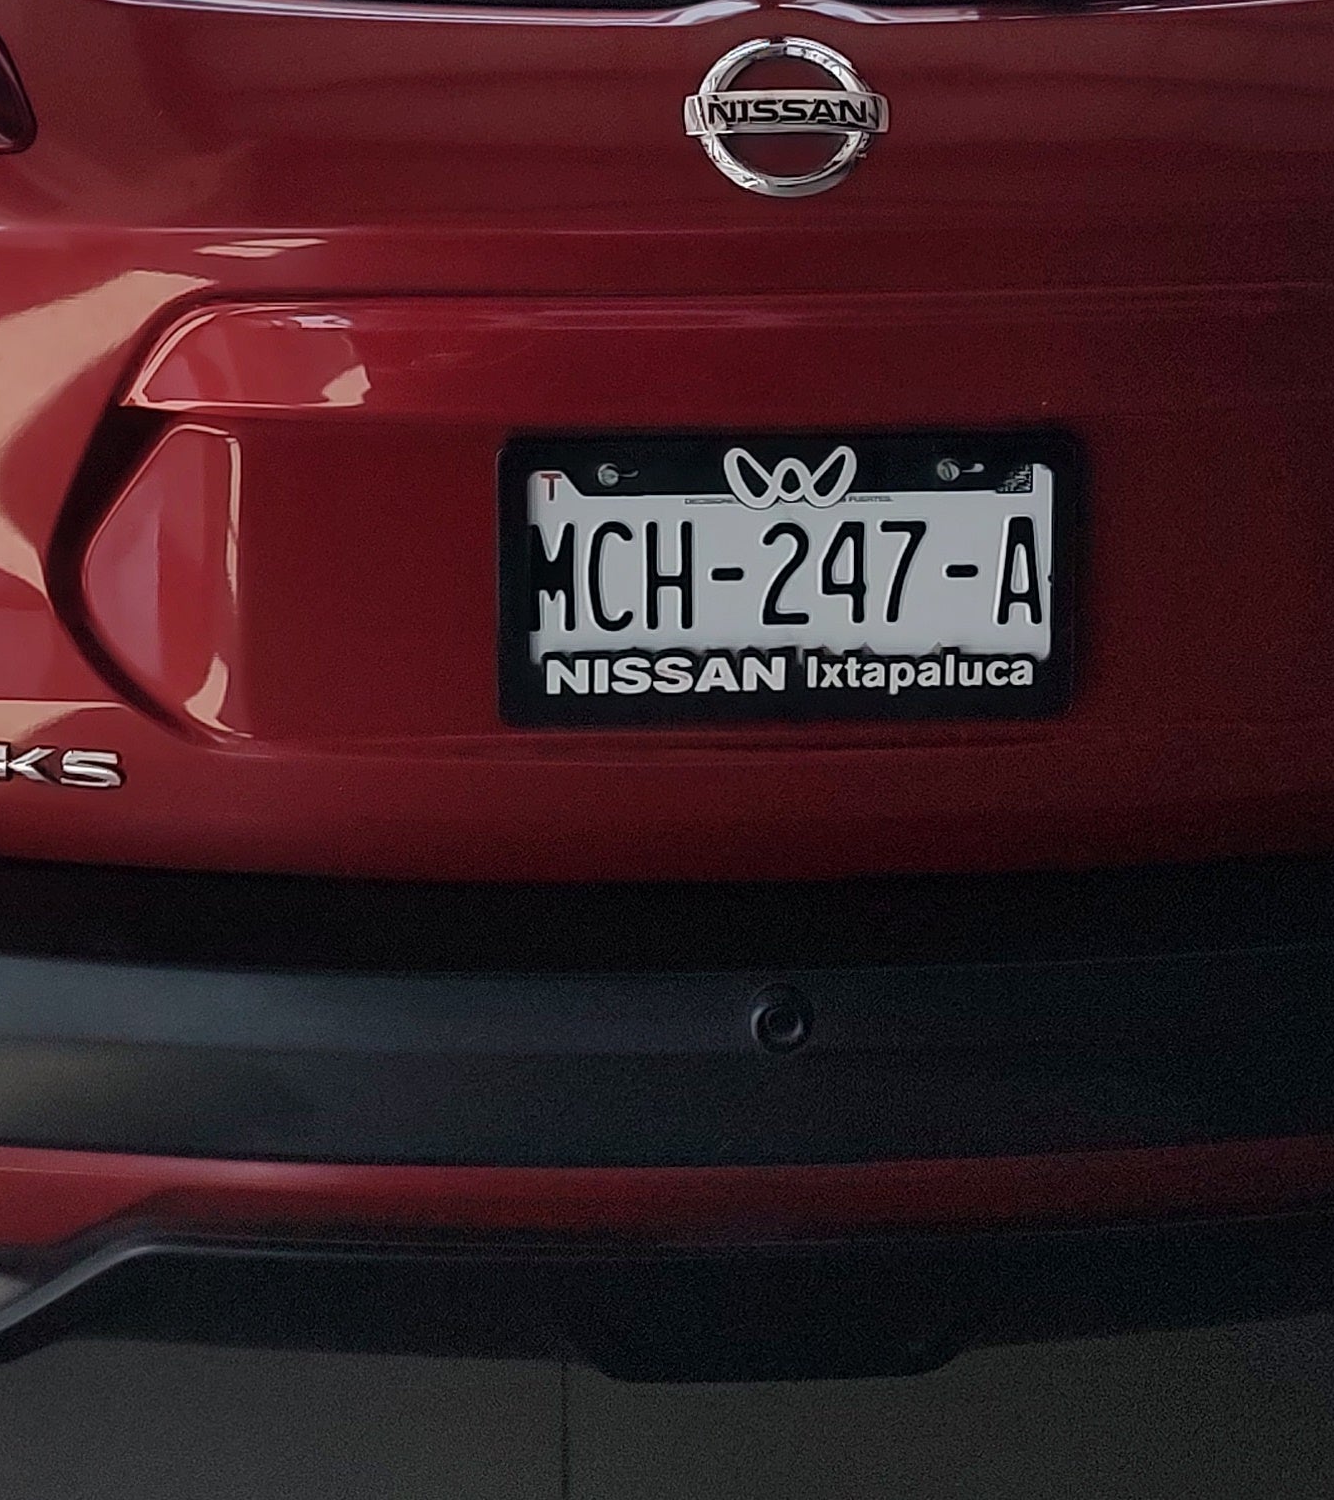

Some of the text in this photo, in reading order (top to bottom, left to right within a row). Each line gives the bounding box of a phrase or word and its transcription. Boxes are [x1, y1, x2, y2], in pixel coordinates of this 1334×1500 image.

[708, 99, 867, 124] NISSAN
[530, 516, 1043, 632] MCH-247-A
[546, 655, 1034, 695] NISSAN Ixtapaluca
